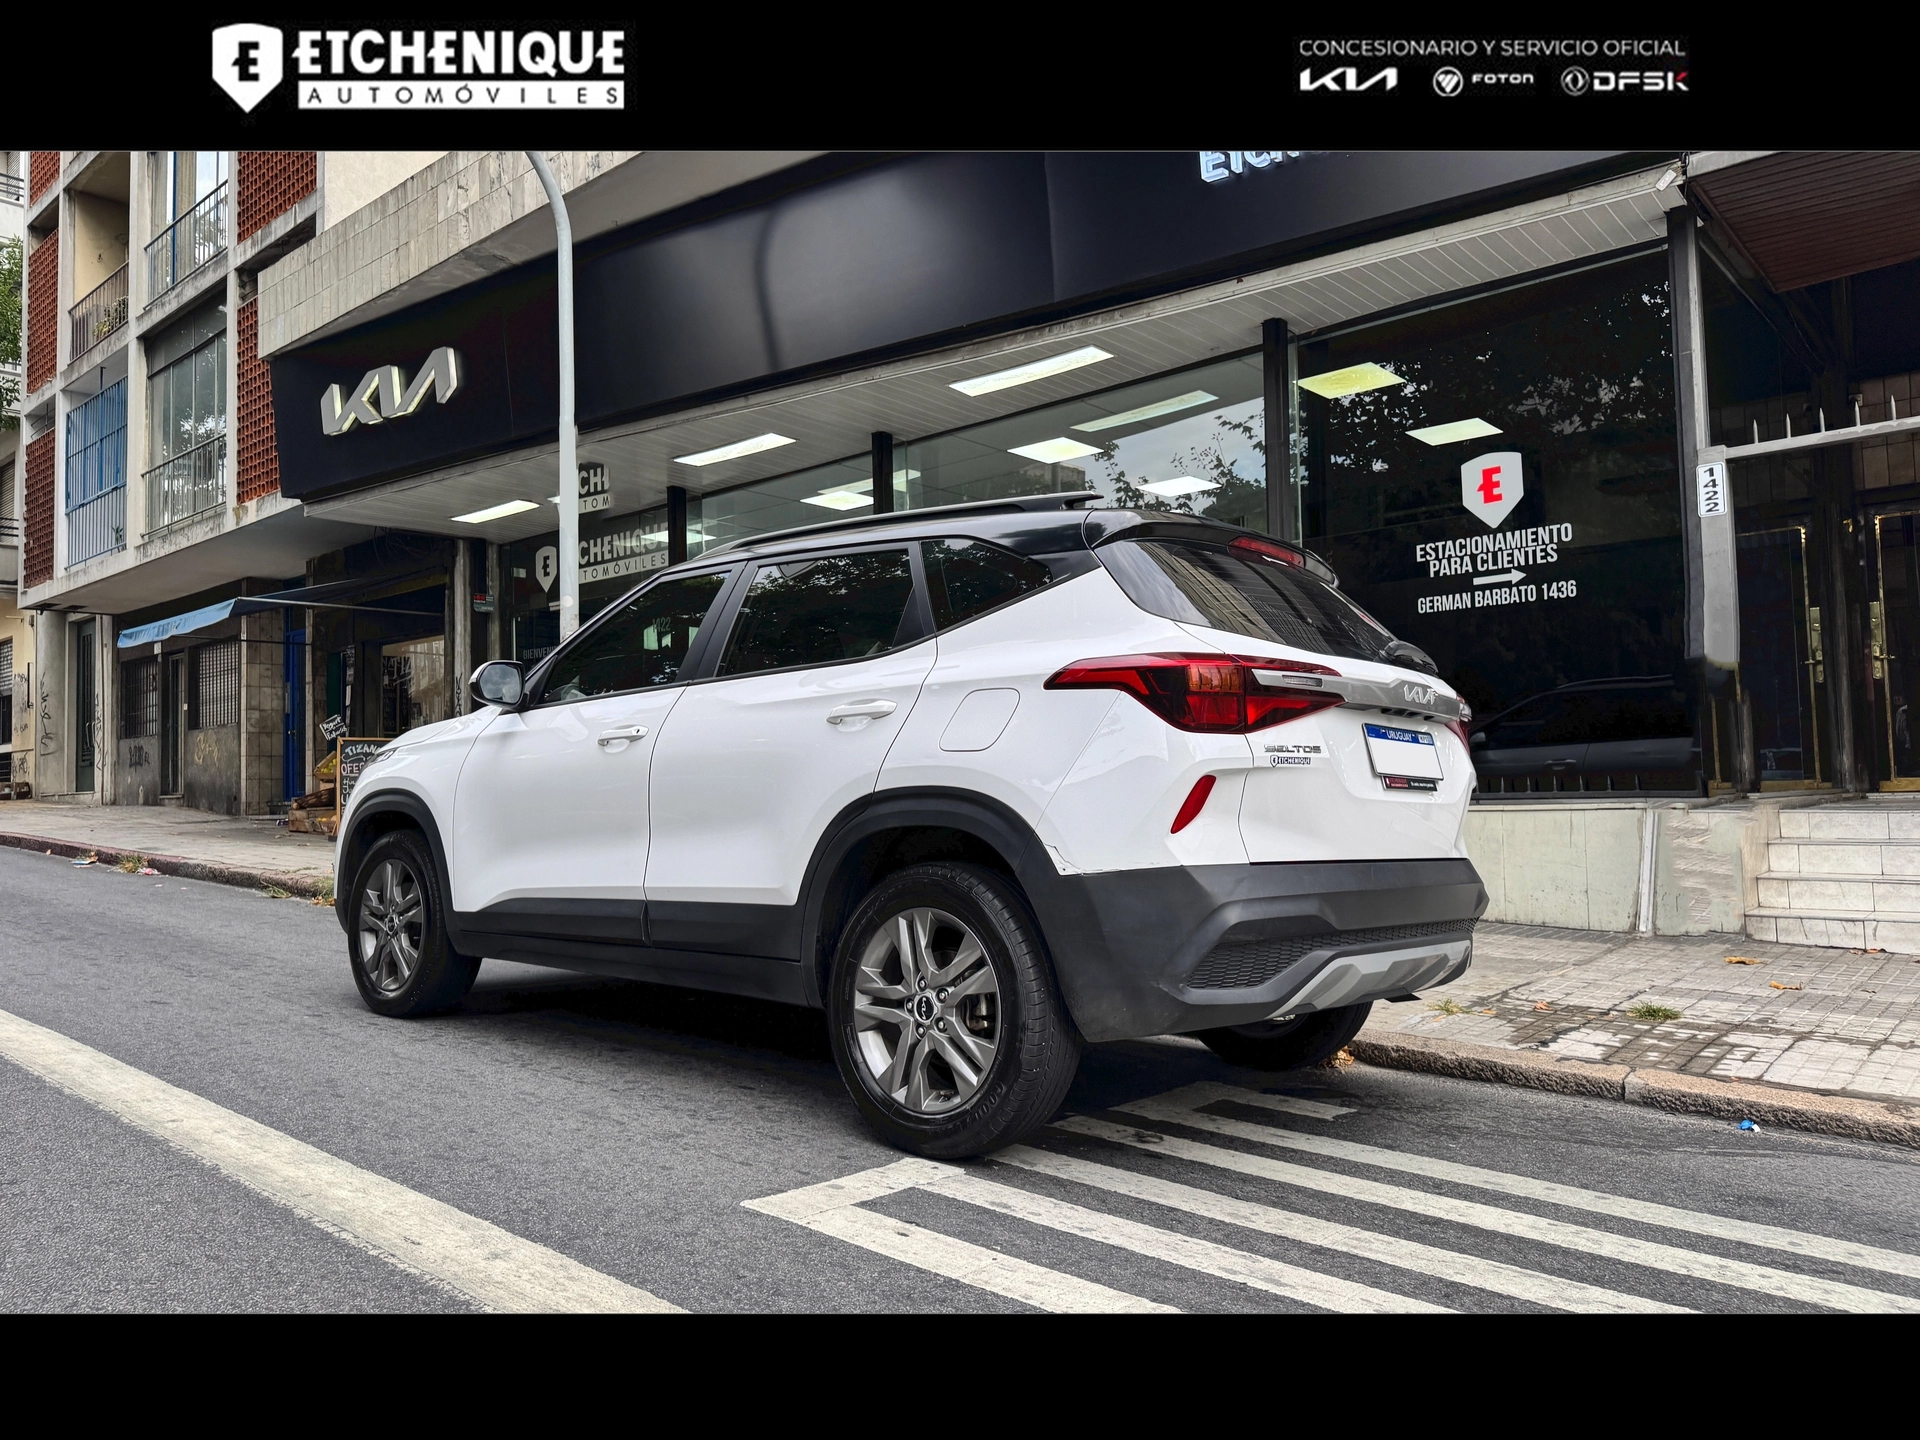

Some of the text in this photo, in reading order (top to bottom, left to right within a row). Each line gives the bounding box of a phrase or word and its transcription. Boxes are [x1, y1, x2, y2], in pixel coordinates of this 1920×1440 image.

[320, 346, 457, 436] KIA
[1703, 466, 1720, 513] 1422
[1416, 522, 1573, 562] ESTACIONAMIENTO
[1429, 543, 1558, 578] PARA CLIENTES
[1417, 579, 1577, 614] GERMAN BARBATO 1436
[1263, 744, 1322, 754] SELTOS
[1386, 730, 1413, 742] URUGUAY
